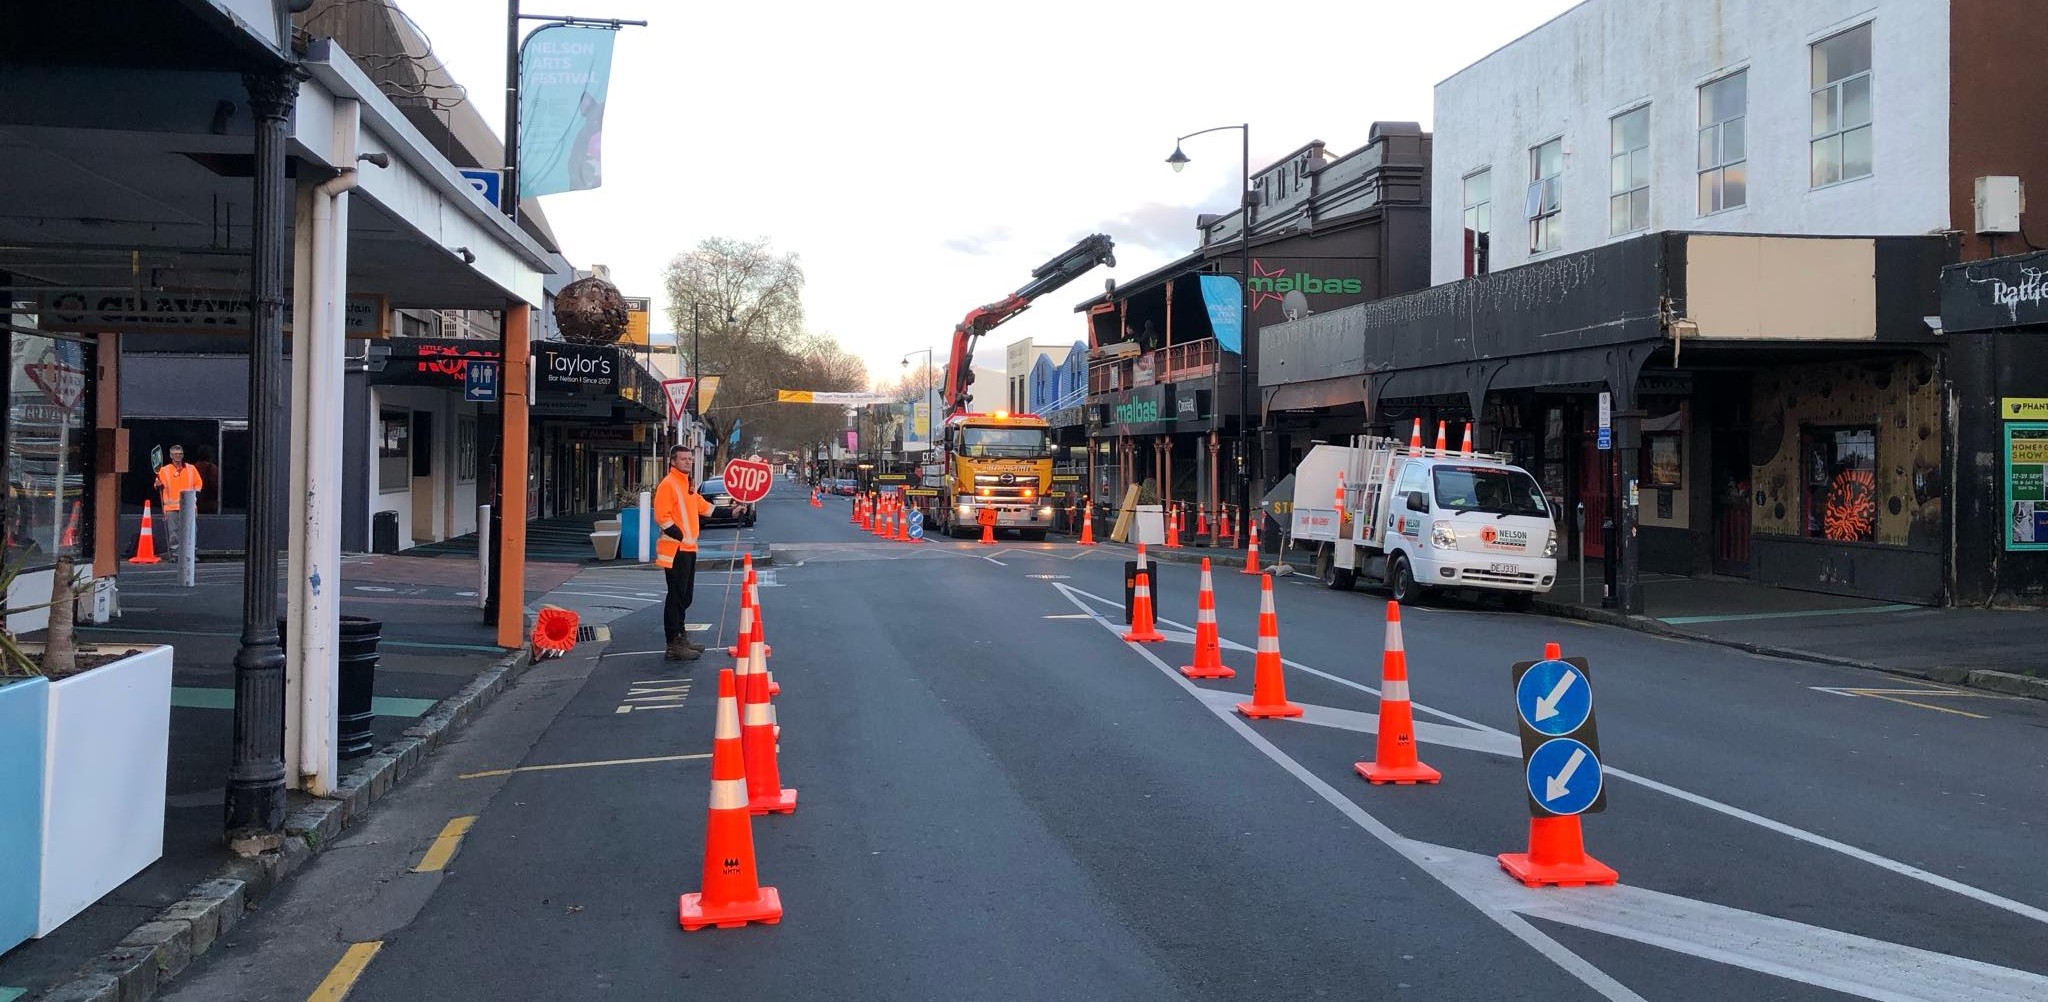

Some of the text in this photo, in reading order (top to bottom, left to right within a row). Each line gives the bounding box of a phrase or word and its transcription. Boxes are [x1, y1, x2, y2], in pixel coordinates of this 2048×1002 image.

[531, 42, 594, 55] NELSON
[531, 56, 572, 69] ARTS
[531, 71, 599, 84] FESTIVAL
[1247, 273, 1361, 294] malbas
[545, 351, 610, 376] Taylor's
[548, 374, 559, 382] Bar
[559, 375, 578, 383] Nelson
[582, 376, 597, 384] Since
[598, 377, 612, 385] 2017
[671, 385, 686, 395] GIVE
[1116, 395, 1157, 424] malbas
[2012, 443, 2037, 451] HOME
[2012, 451, 2043, 459] SHOW
[727, 465, 768, 492] STOP
[1499, 529, 1527, 539] NELSON
